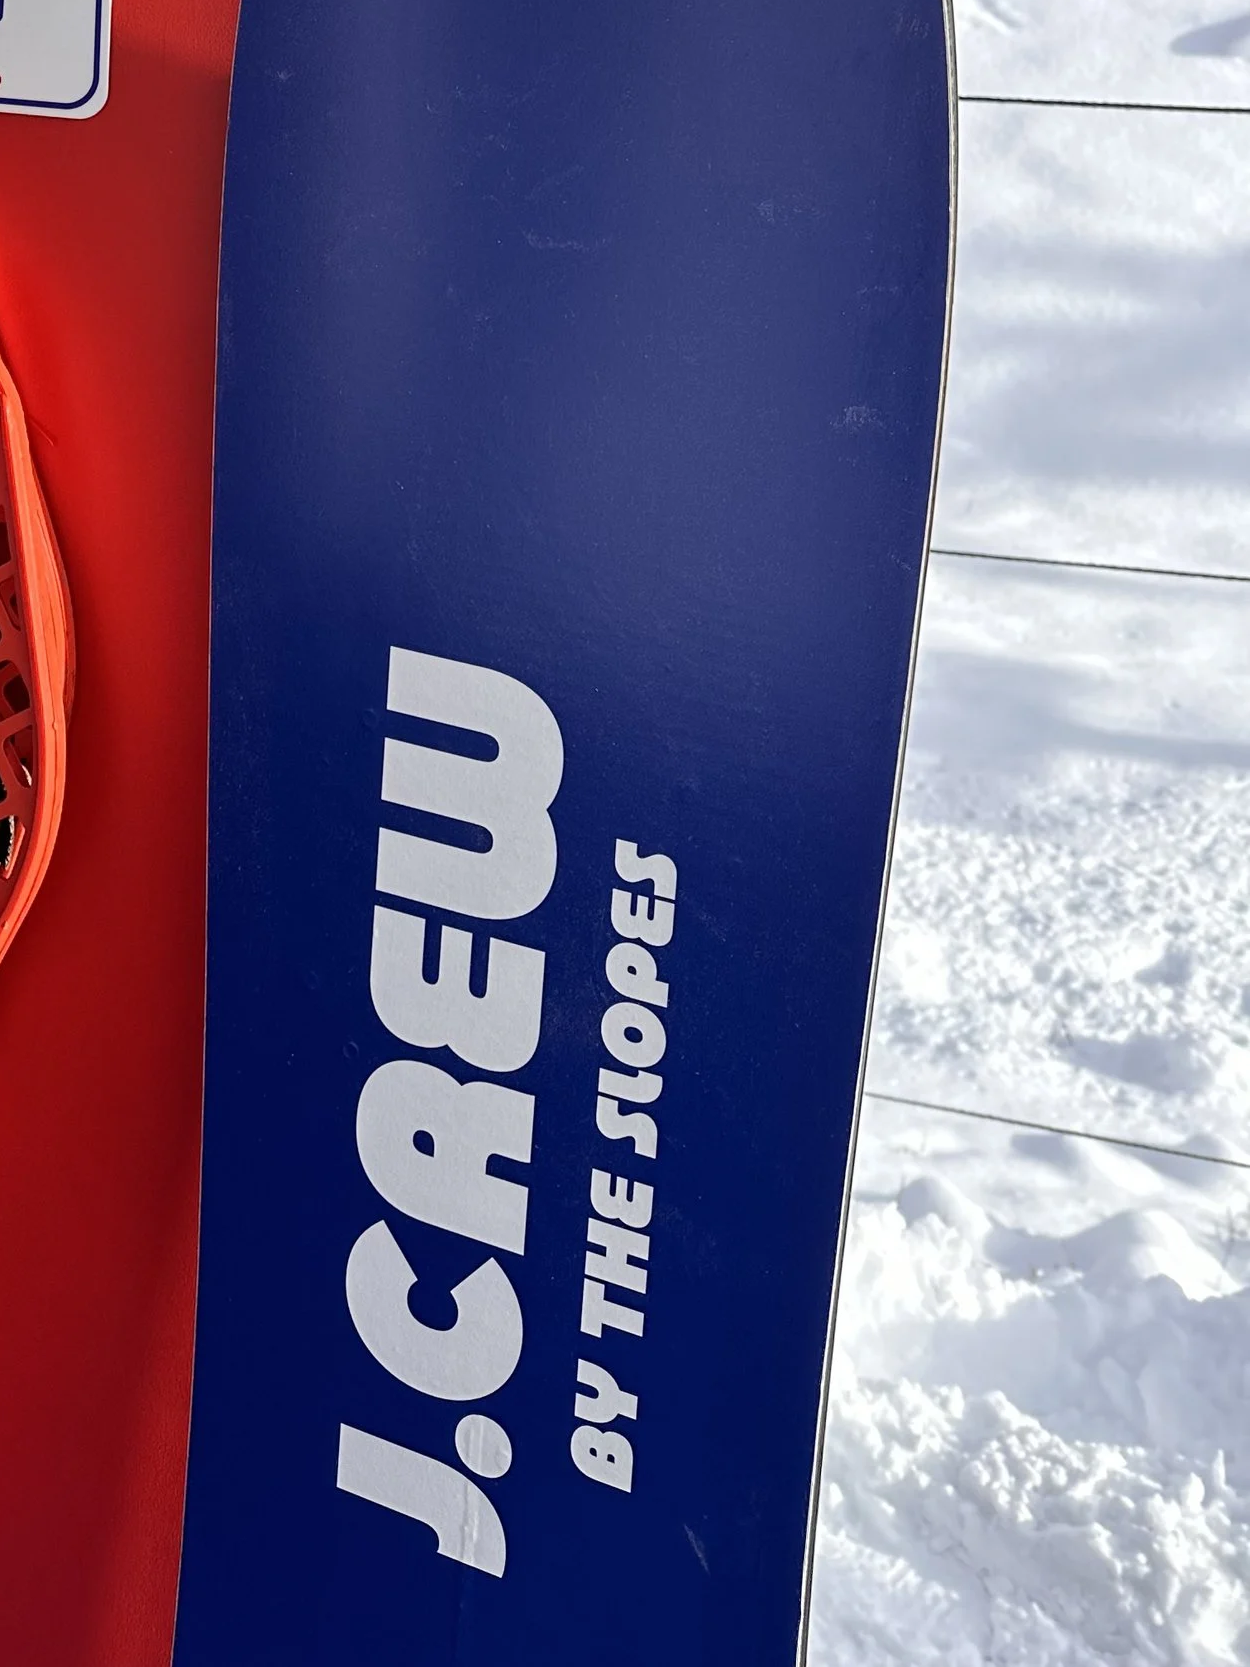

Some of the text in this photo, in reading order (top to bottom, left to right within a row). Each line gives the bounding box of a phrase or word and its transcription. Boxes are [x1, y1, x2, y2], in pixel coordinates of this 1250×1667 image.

[337, 645, 564, 1578] J.CREW
[570, 838, 678, 1494] BY THE SLOPES
